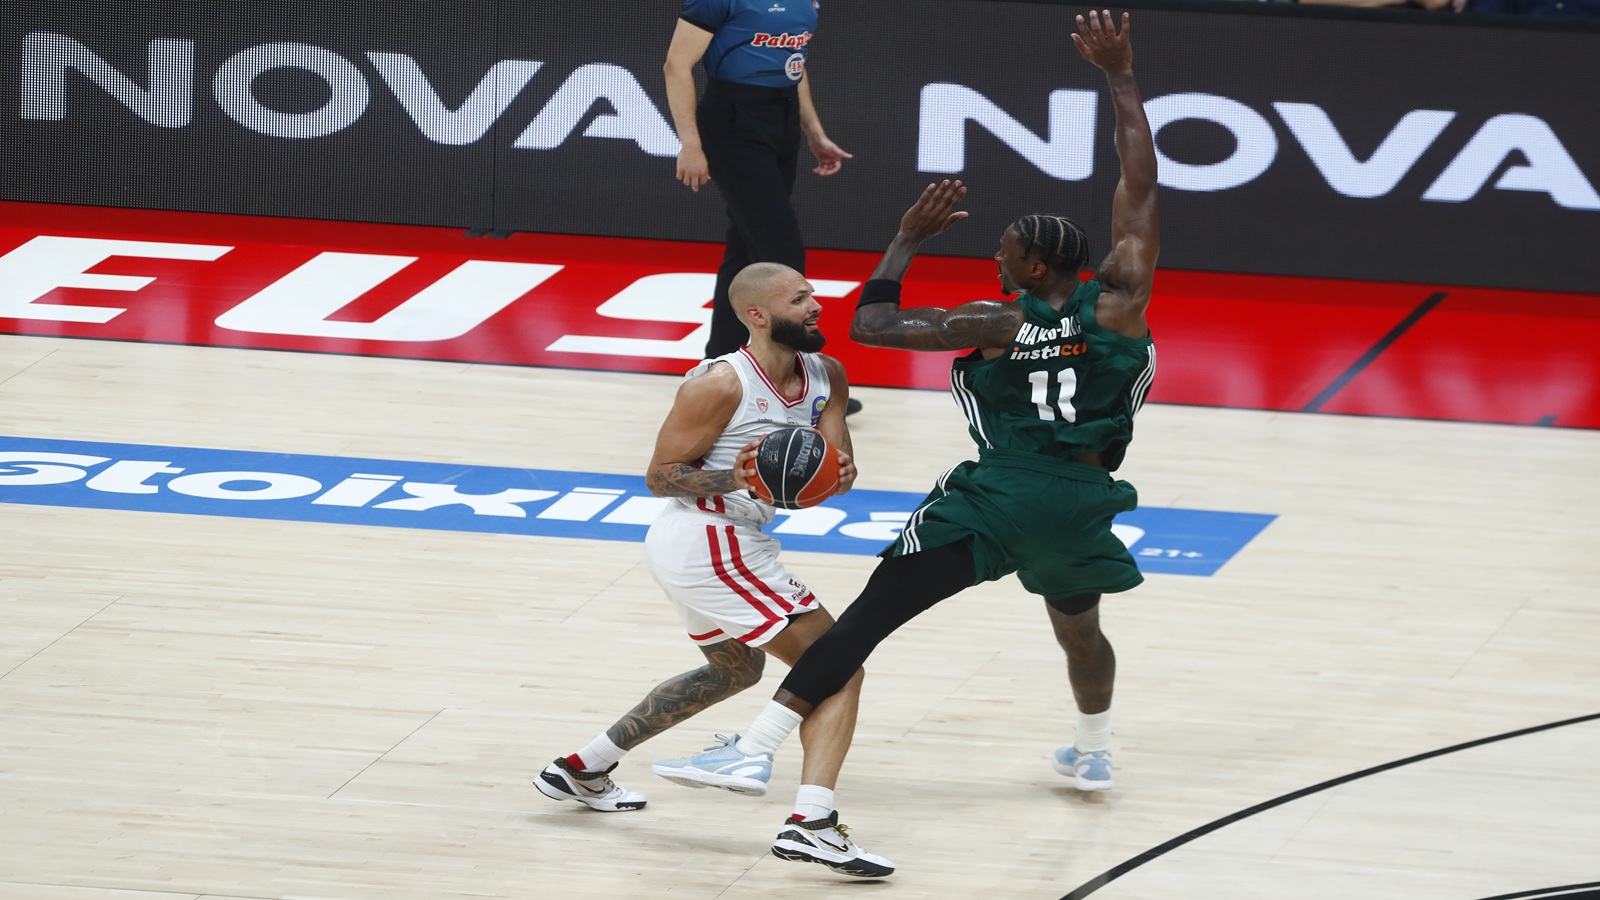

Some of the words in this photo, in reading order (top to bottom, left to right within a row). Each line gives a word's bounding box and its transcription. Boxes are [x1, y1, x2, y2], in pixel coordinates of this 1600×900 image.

[20, 31, 682, 157] NOVA
[917, 82, 1600, 211] NOVA
[1028, 367, 1077, 423] 11
[1138, 547, 1204, 560] 21+
